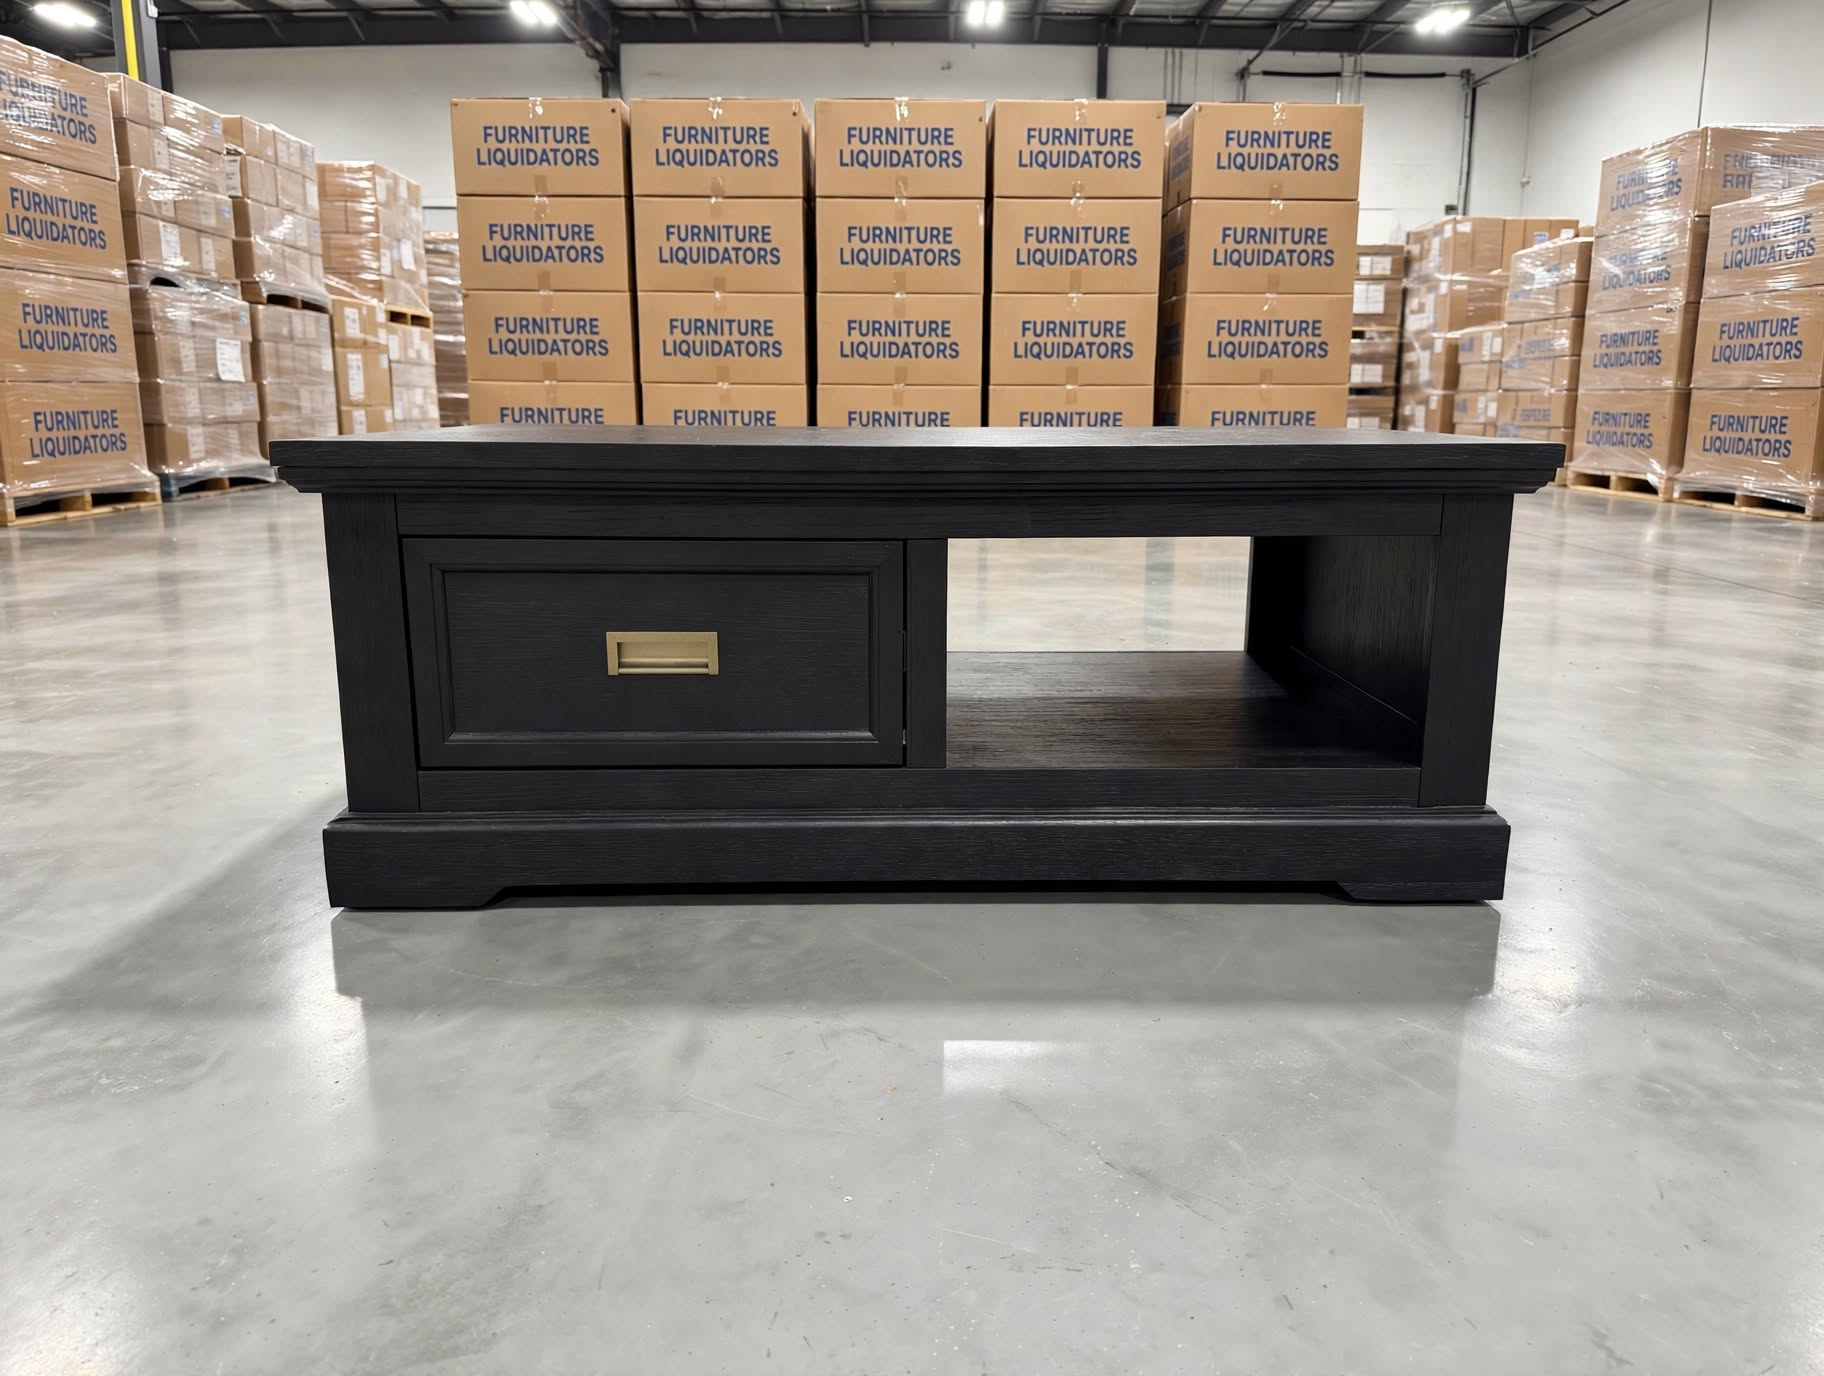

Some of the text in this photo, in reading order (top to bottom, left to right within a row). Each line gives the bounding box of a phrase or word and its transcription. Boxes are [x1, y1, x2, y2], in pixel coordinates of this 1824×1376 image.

[483, 126, 591, 144] FURNITURE
[662, 126, 770, 145] FURNITURE
[846, 126, 955, 144] FURNITURE
[1026, 128, 1134, 145] FURNITURE
[1225, 130, 1333, 148] FURNITURE
[476, 149, 600, 167] LIQUIDATORS
[655, 149, 779, 168] LIQUIDATORS
[838, 148, 963, 168] LIQUIDATORS
[1018, 151, 1141, 169] LIQUIDATORS
[1216, 152, 1339, 171] LIQUIDATORS
[9, 187, 98, 224] FURNITURE
[5, 212, 107, 250] LIQUIDATORS
[489, 224, 594, 241] FURNITURE
[666, 225, 772, 242] FURNITURE
[846, 226, 953, 244] FURNITURE
[1024, 227, 1130, 244] FURNITURE
[1222, 227, 1328, 244] FURNITURE
[482, 246, 604, 263] LIQUIDATORS
[659, 247, 780, 265] LIQUIDATORS
[838, 248, 961, 266] LIQUIDATORS
[1015, 248, 1138, 266] LIQUIDATORS
[1212, 249, 1335, 267] LIQUIDATORS
[21, 303, 109, 329] FURNITURE
[494, 317, 599, 334] FURNITURE
[669, 318, 774, 336] FURNITURE
[846, 319, 951, 337] FURNITURE
[1021, 320, 1126, 337] FURNITURE
[1216, 320, 1322, 337] FURNITURE
[1719, 317, 1800, 340] FURNITURE
[18, 329, 117, 353] LIQUIDATORS
[1599, 328, 1660, 348] FURNITURE
[488, 339, 609, 357] LIQUIDATORS
[662, 340, 783, 358] LIQUIDATORS
[838, 341, 960, 359] LIQUIDATORS
[1013, 342, 1134, 360] LIQUIDATORS
[1207, 341, 1329, 359] LIQUIDATORS
[1711, 340, 1803, 364] LIQUIDATORS
[1593, 349, 1662, 369] LIQUIDATORS
[33, 409, 119, 432] FURNITURE
[500, 408, 604, 424] FURNITURE
[673, 410, 776, 426] FURNITURE
[846, 410, 951, 426] FURNITURE
[1019, 412, 1123, 427] FURNITURE
[1210, 411, 1317, 425] FURNITURE
[1591, 410, 1651, 429] FURNITURE
[1710, 414, 1789, 435] FURNITURE
[29, 432, 128, 458] LIQUIDATORS
[1586, 430, 1653, 449] LIQUIDATORS
[1702, 435, 1792, 458] LIQUIDATORS
